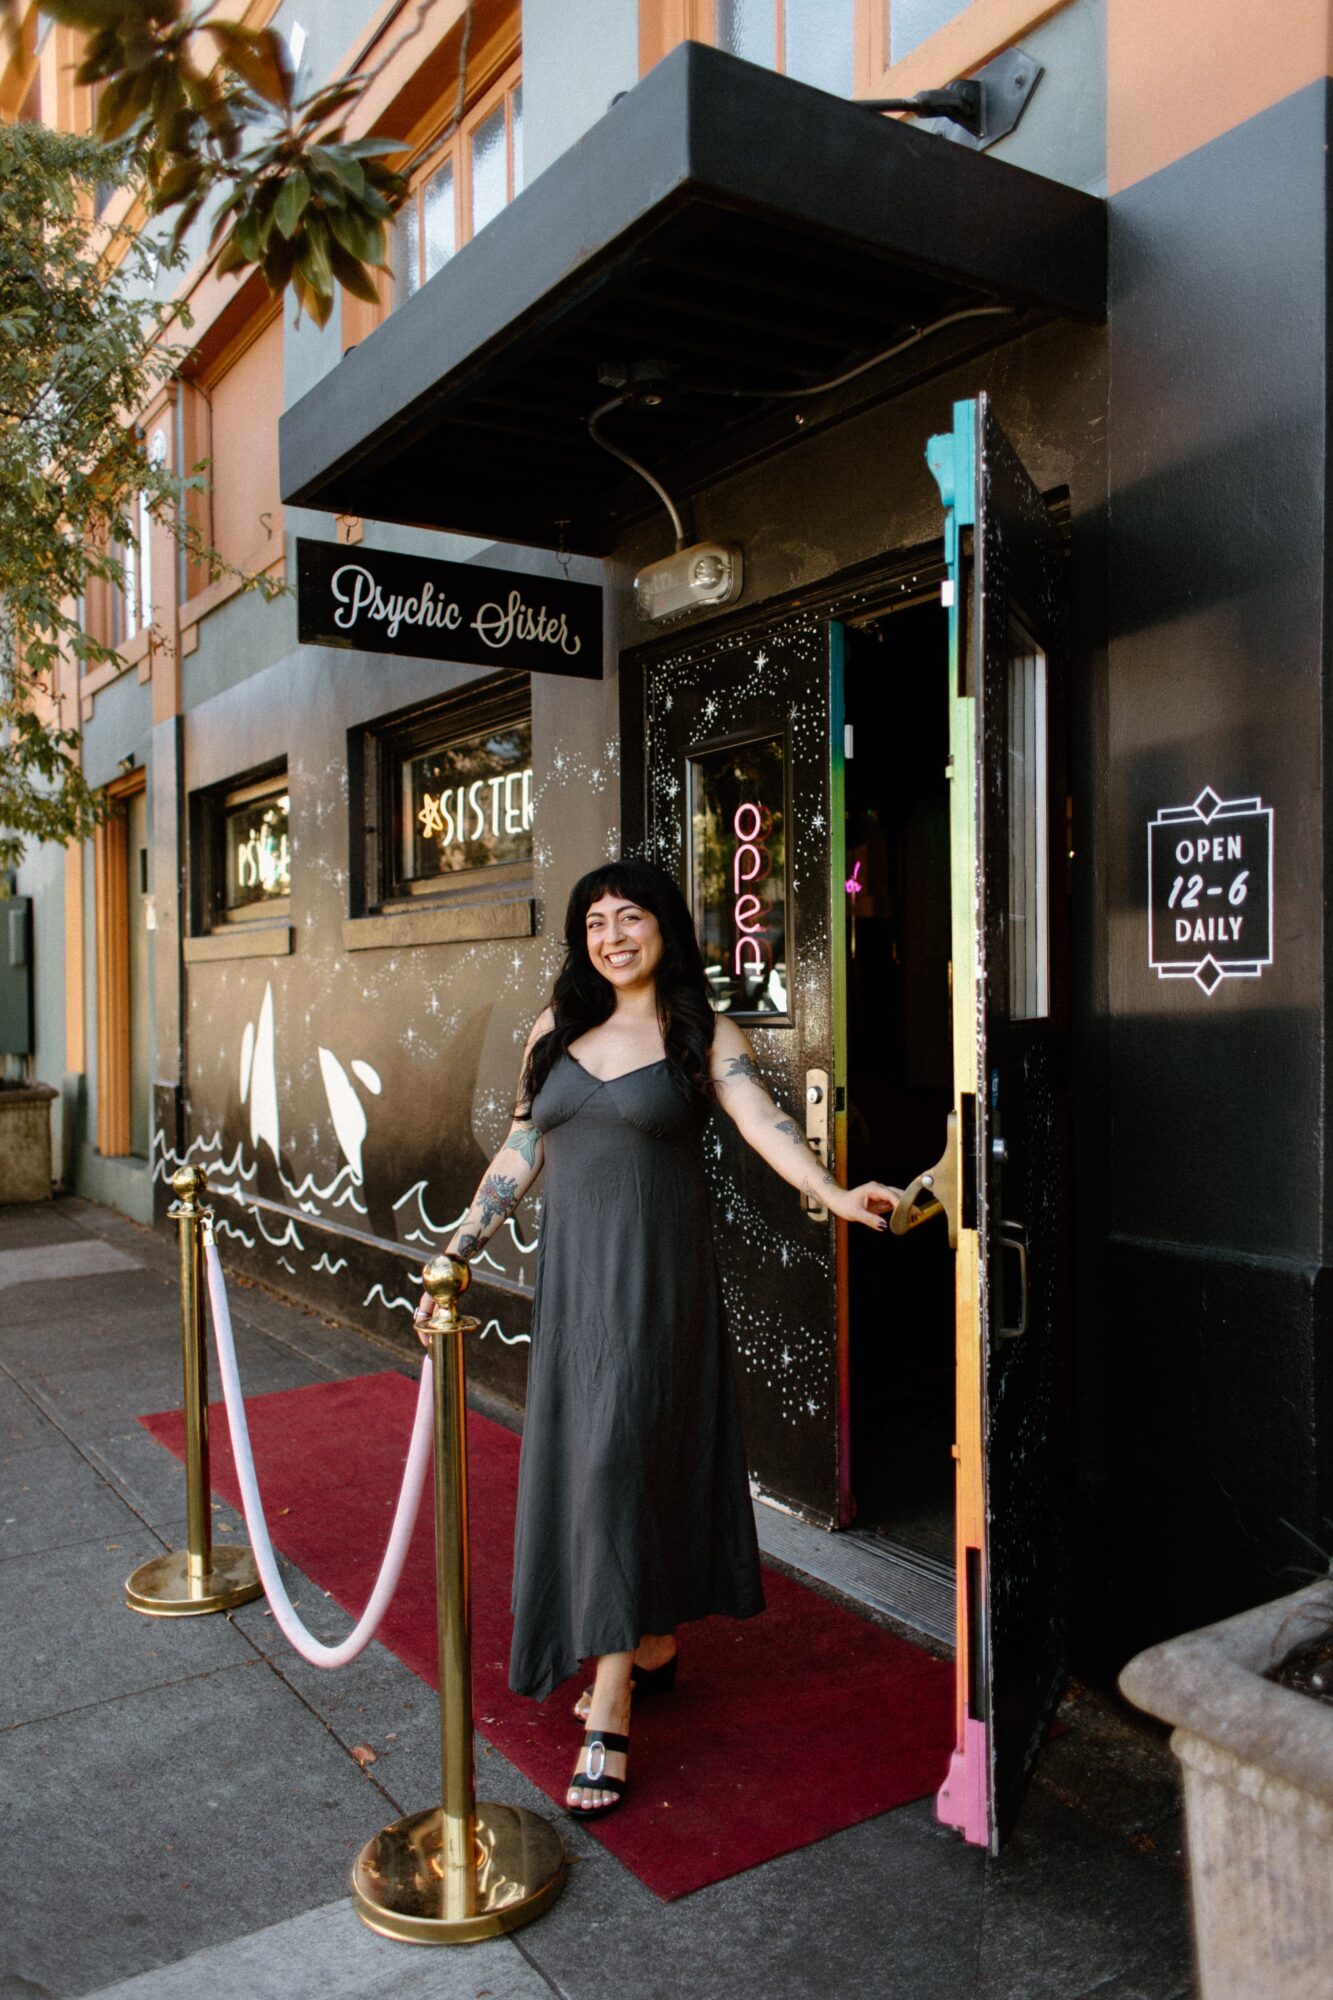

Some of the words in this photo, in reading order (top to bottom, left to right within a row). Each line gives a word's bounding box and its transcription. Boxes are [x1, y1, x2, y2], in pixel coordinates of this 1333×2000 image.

[331, 564, 462, 638] Psychic
[470, 590, 581, 655] Sister
[1175, 835, 1241, 864] OPEN
[734, 803, 761, 976] open
[1168, 870, 1249, 909] 12-6
[1175, 917, 1242, 942] DAILY
